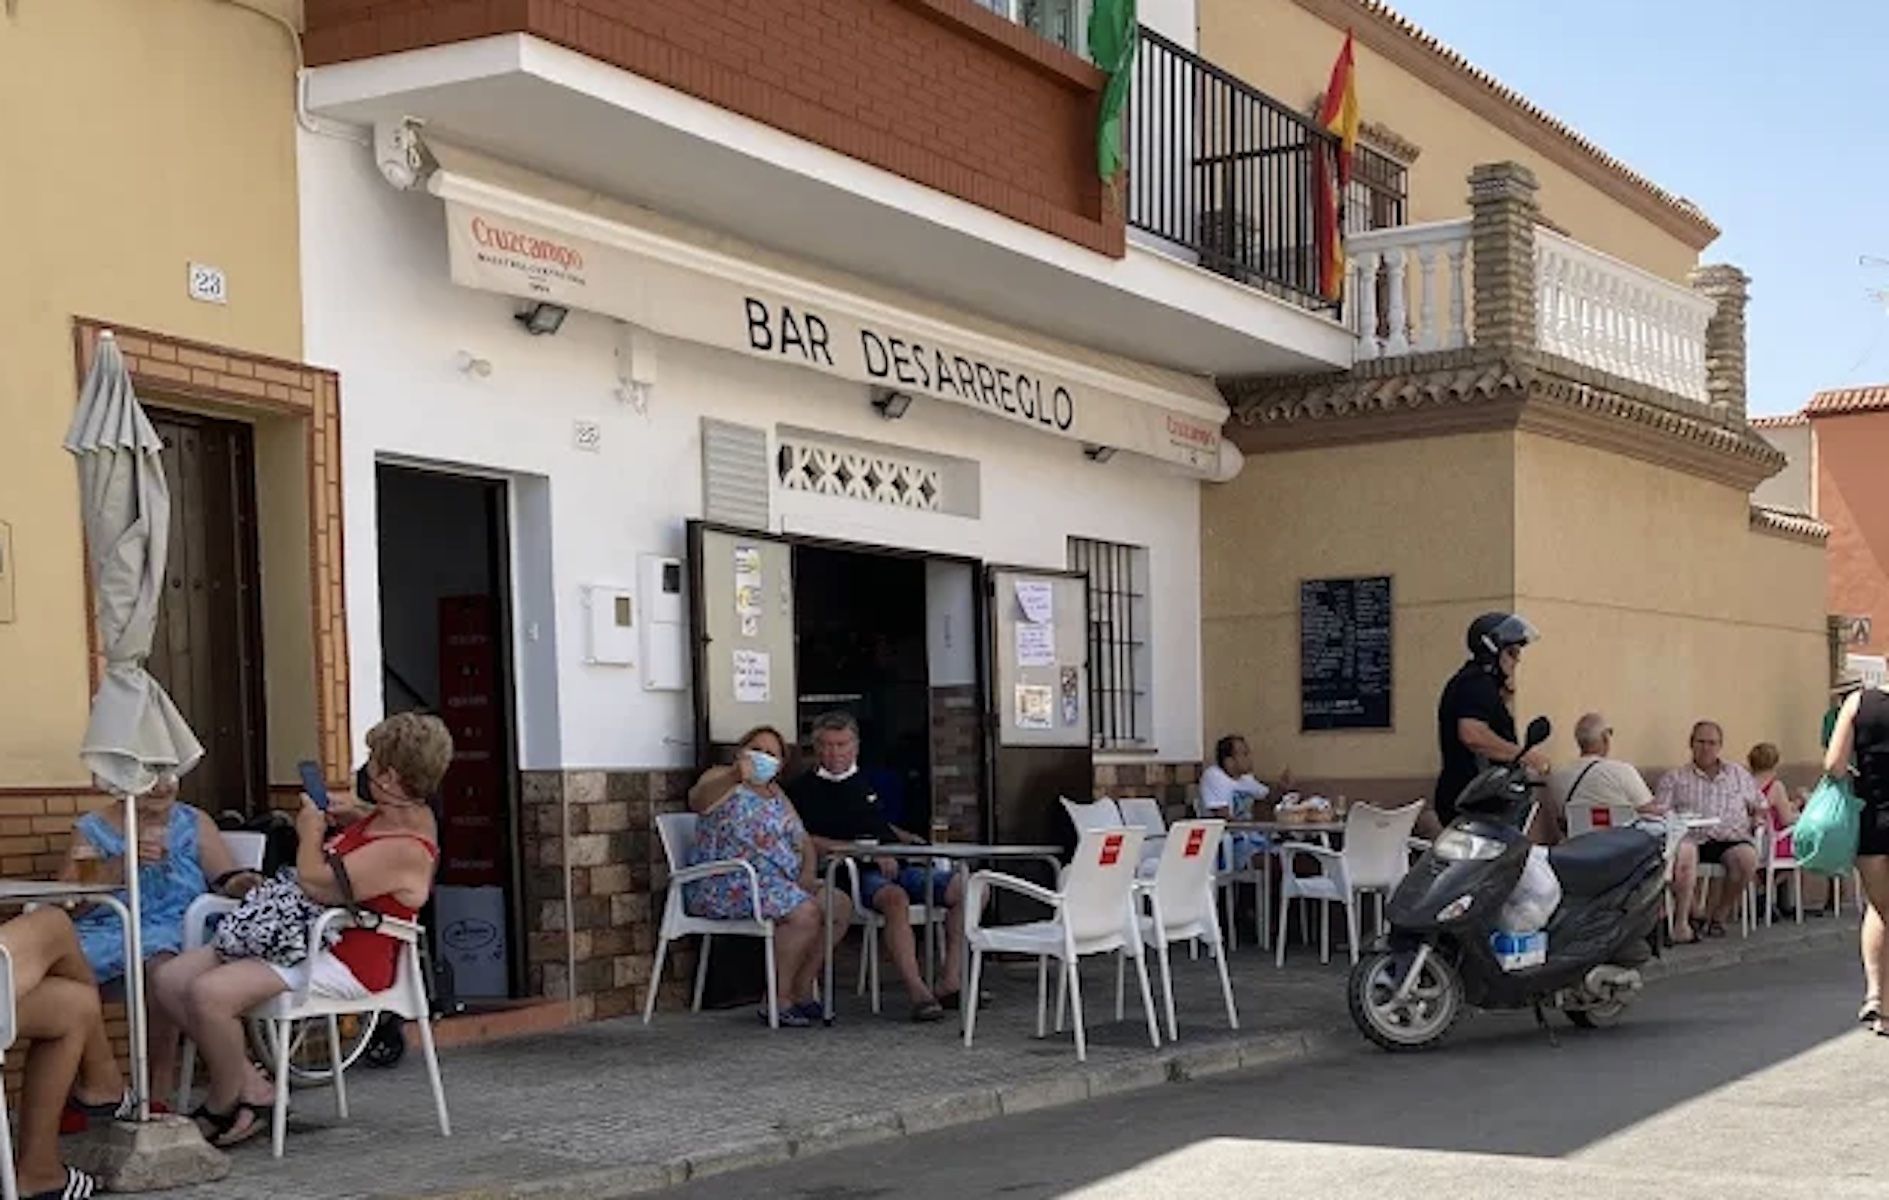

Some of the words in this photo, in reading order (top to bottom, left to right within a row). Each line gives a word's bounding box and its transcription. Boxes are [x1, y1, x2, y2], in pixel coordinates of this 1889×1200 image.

[471, 216, 584, 271] Cruzcampo
[744, 297, 834, 365] BAR
[861, 329, 1073, 430] DESARREGLO
